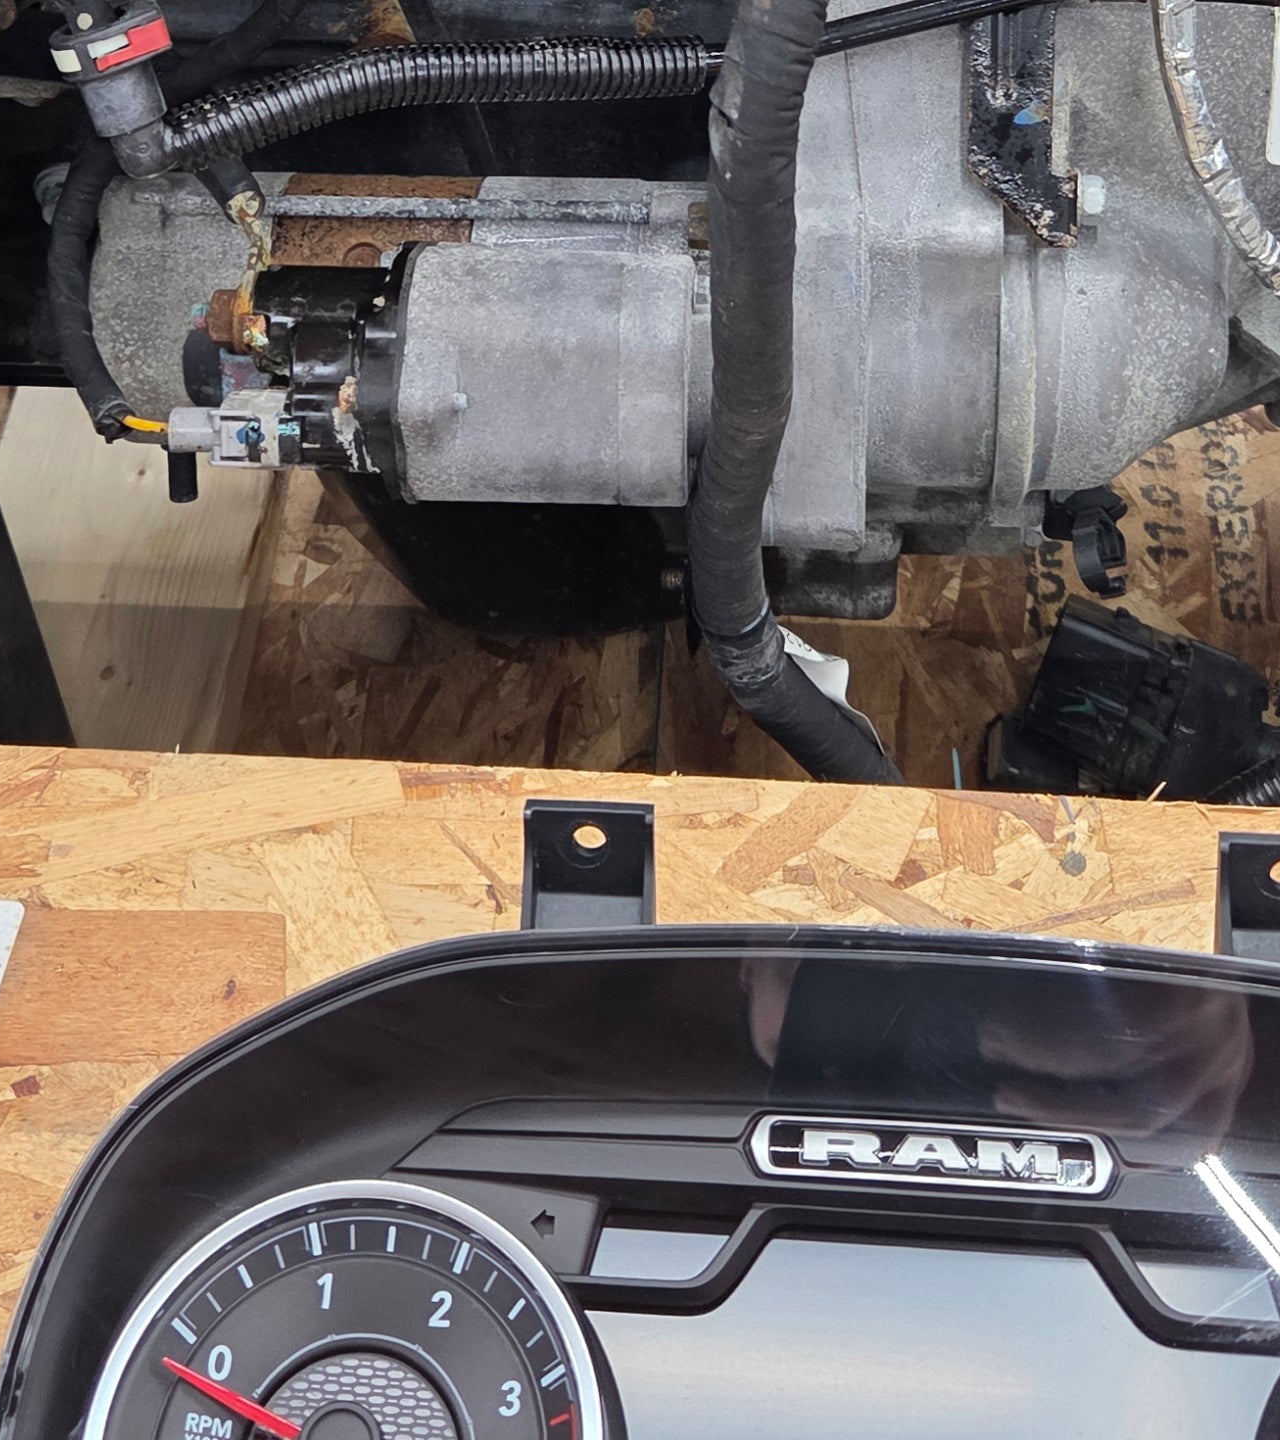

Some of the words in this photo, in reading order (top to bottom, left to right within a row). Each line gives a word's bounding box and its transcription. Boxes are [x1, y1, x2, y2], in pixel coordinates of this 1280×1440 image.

[798, 1128, 1062, 1178] RAM
[317, 1272, 333, 1310] 1
[428, 1291, 453, 1327] 2
[207, 1344, 233, 1381] 0
[498, 1380, 522, 1417] 3
[185, 1411, 233, 1440] RPM
